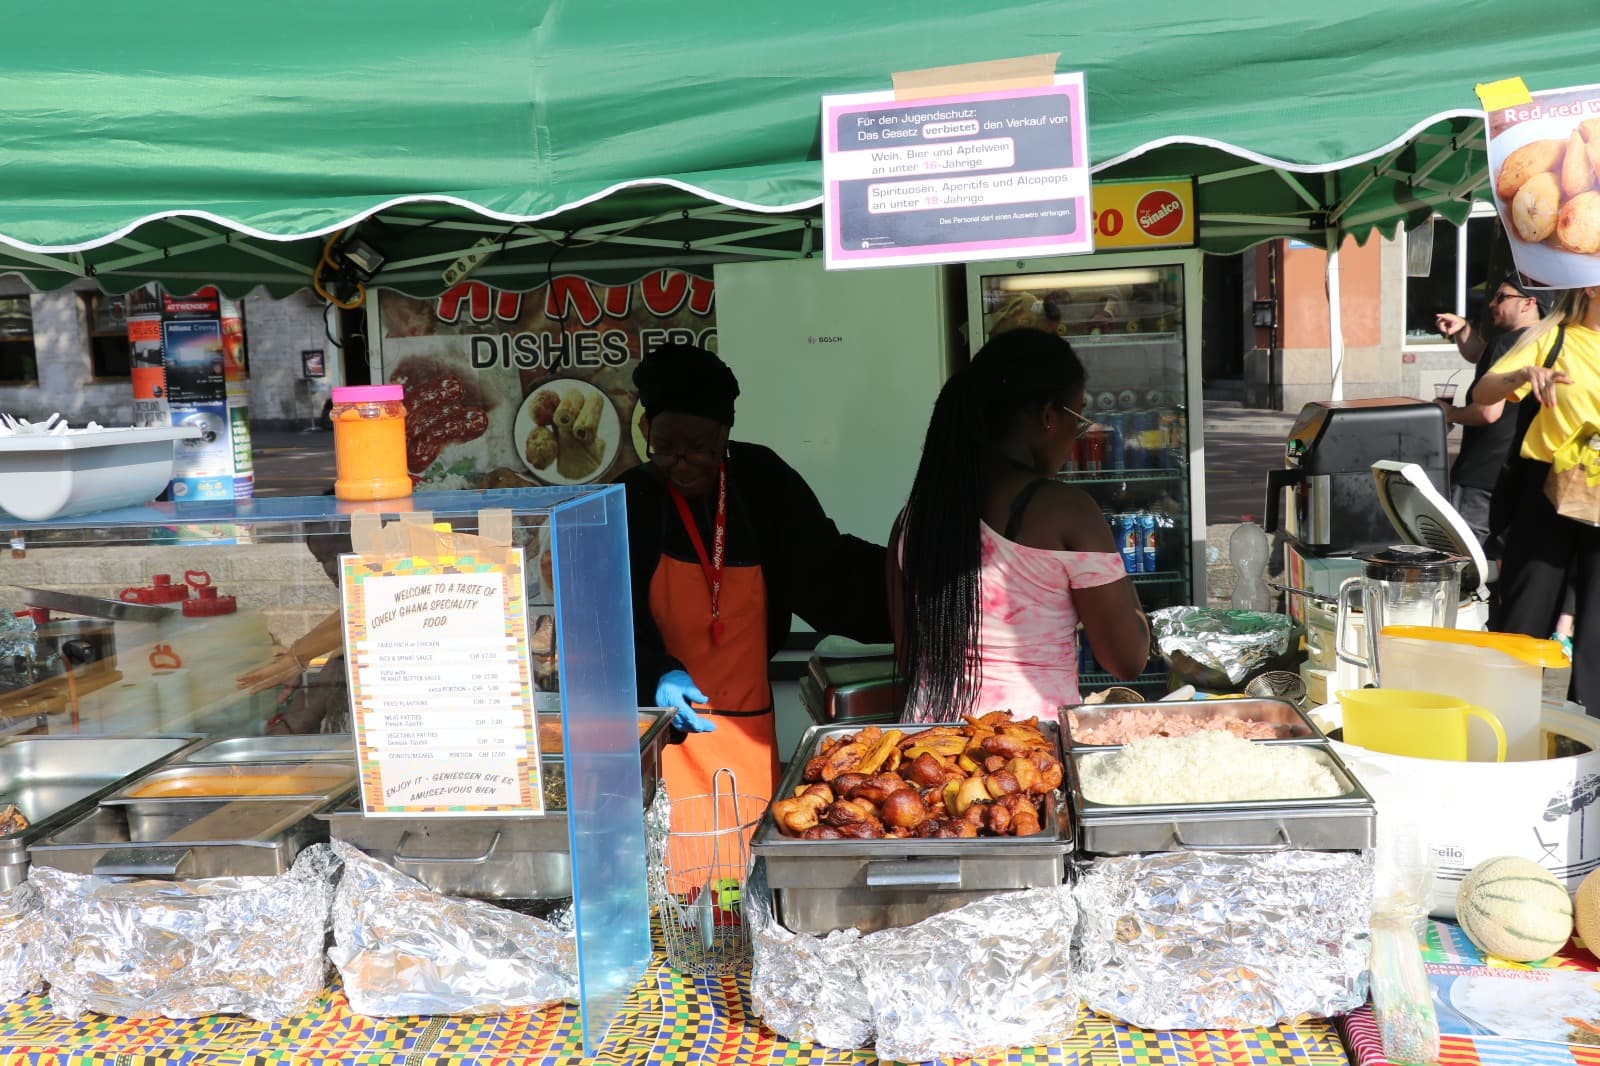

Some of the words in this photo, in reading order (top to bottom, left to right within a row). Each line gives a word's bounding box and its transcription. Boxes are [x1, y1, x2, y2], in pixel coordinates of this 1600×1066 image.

[857, 117, 875, 127] Für
[879, 115, 898, 126] den
[901, 108, 977, 125] Jugendschutz:
[1504, 105, 1542, 122] Red
[1549, 100, 1583, 117] red
[858, 130, 879, 141] Das
[882, 127, 918, 140] Gesetz
[926, 122, 977, 135] verbietet
[984, 119, 1003, 130] den
[1006, 115, 1046, 128] Verkauf
[1049, 115, 1068, 124] von
[871, 151, 902, 162] Wein,
[907, 148, 930, 159] Bier
[933, 146, 953, 157] und
[957, 141, 1010, 156] Apfelwein
[871, 166, 885, 174] an
[888, 162, 919, 173] unter
[872, 184, 935, 198] Spirituosen,
[942, 179, 989, 192] Aperitifs
[993, 177, 1013, 188] und
[1017, 172, 1069, 188] Alcopops
[873, 201, 887, 210] an
[890, 197, 920, 208] unter
[1140, 200, 1179, 228] Sinalco
[953, 215, 980, 224] Personal
[470, 329, 630, 370] DISHES
[394, 584, 433, 604] WELCOME
[434, 583, 446, 594] TO
[448, 583, 455, 593] A
[457, 583, 481, 595] TASTE
[483, 587, 497, 597] OF
[371, 610, 397, 629] LOVELY
[399, 604, 428, 617] GHANA
[429, 600, 478, 611] SPECIALITY
[422, 615, 447, 629] FOOD
[386, 781, 412, 798] ENJOY
[414, 776, 423, 785] IT
[432, 772, 480, 781] GENIESSEN
[484, 774, 499, 782] SIE
[501, 777, 514, 785] ES
[410, 786, 473, 802] AMUSEZ-VOUS
[474, 786, 496, 795] BIEN
